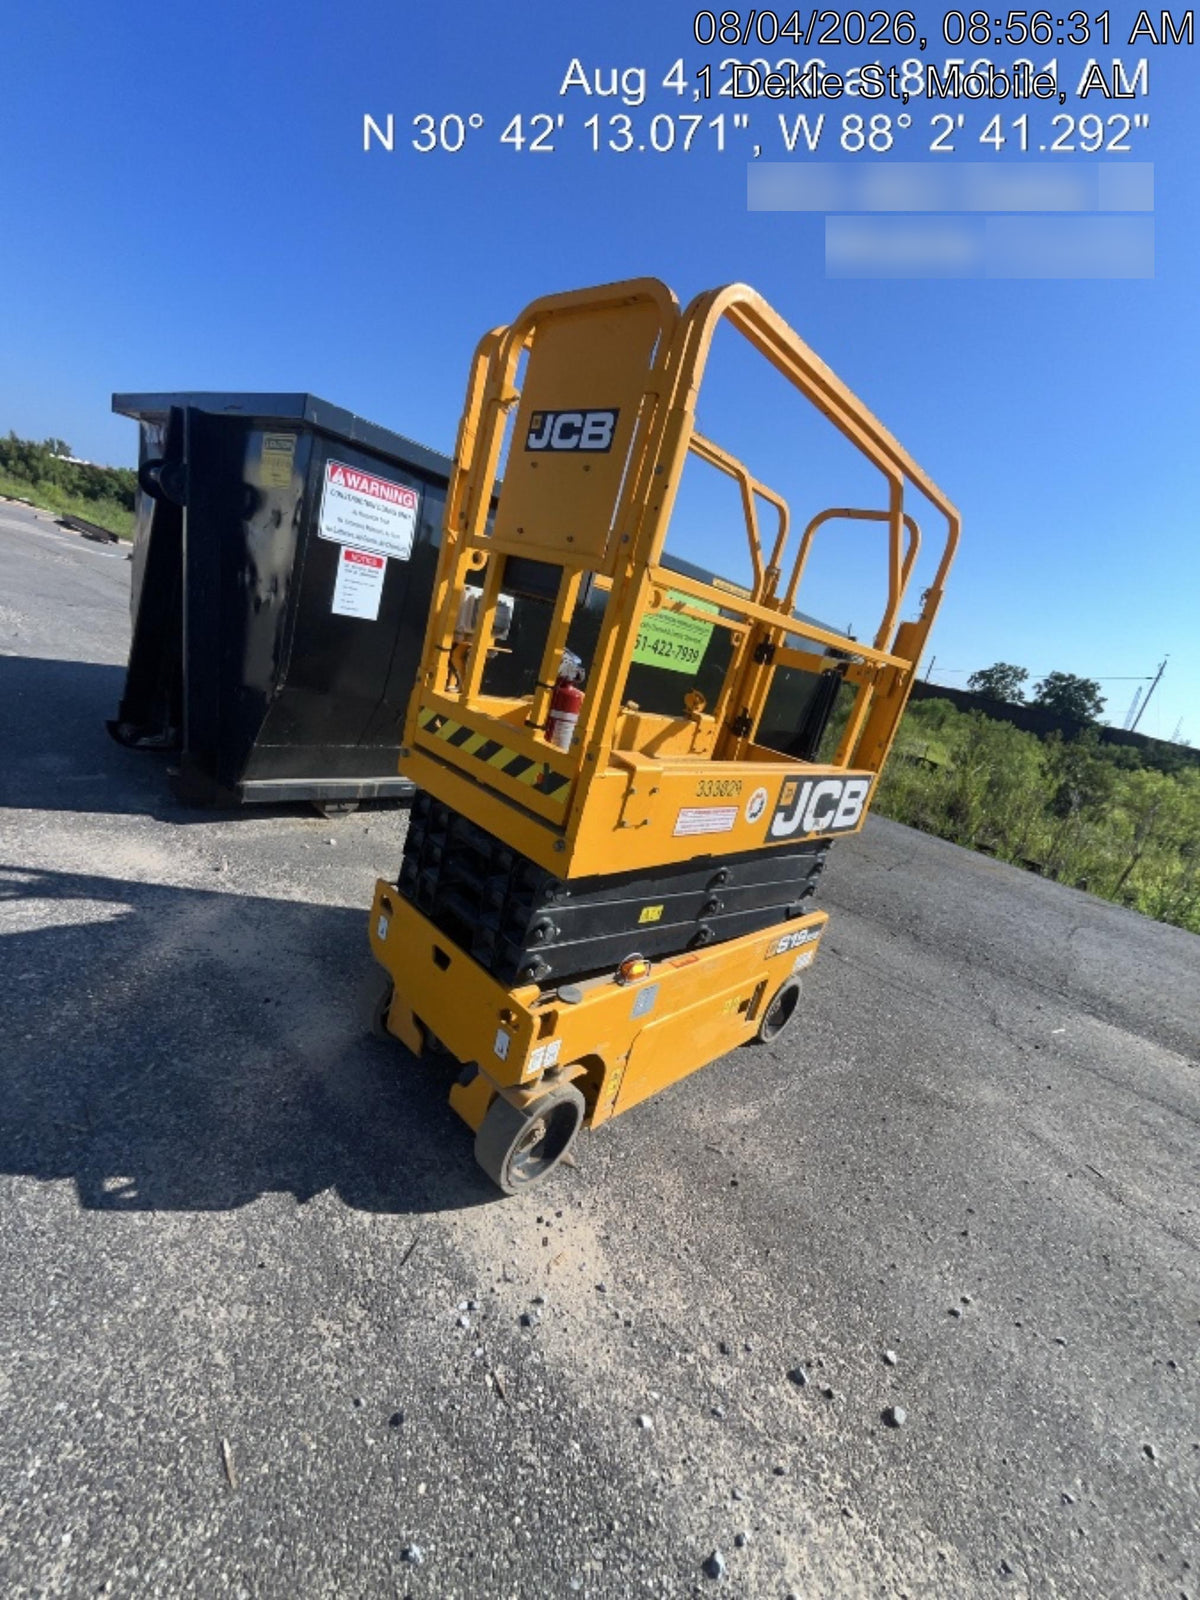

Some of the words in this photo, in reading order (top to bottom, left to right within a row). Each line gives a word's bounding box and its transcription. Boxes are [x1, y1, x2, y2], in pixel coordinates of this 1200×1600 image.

[527, 411, 615, 449] JCB
[344, 471, 414, 508] WARNING
[770, 779, 870, 837] JCB
